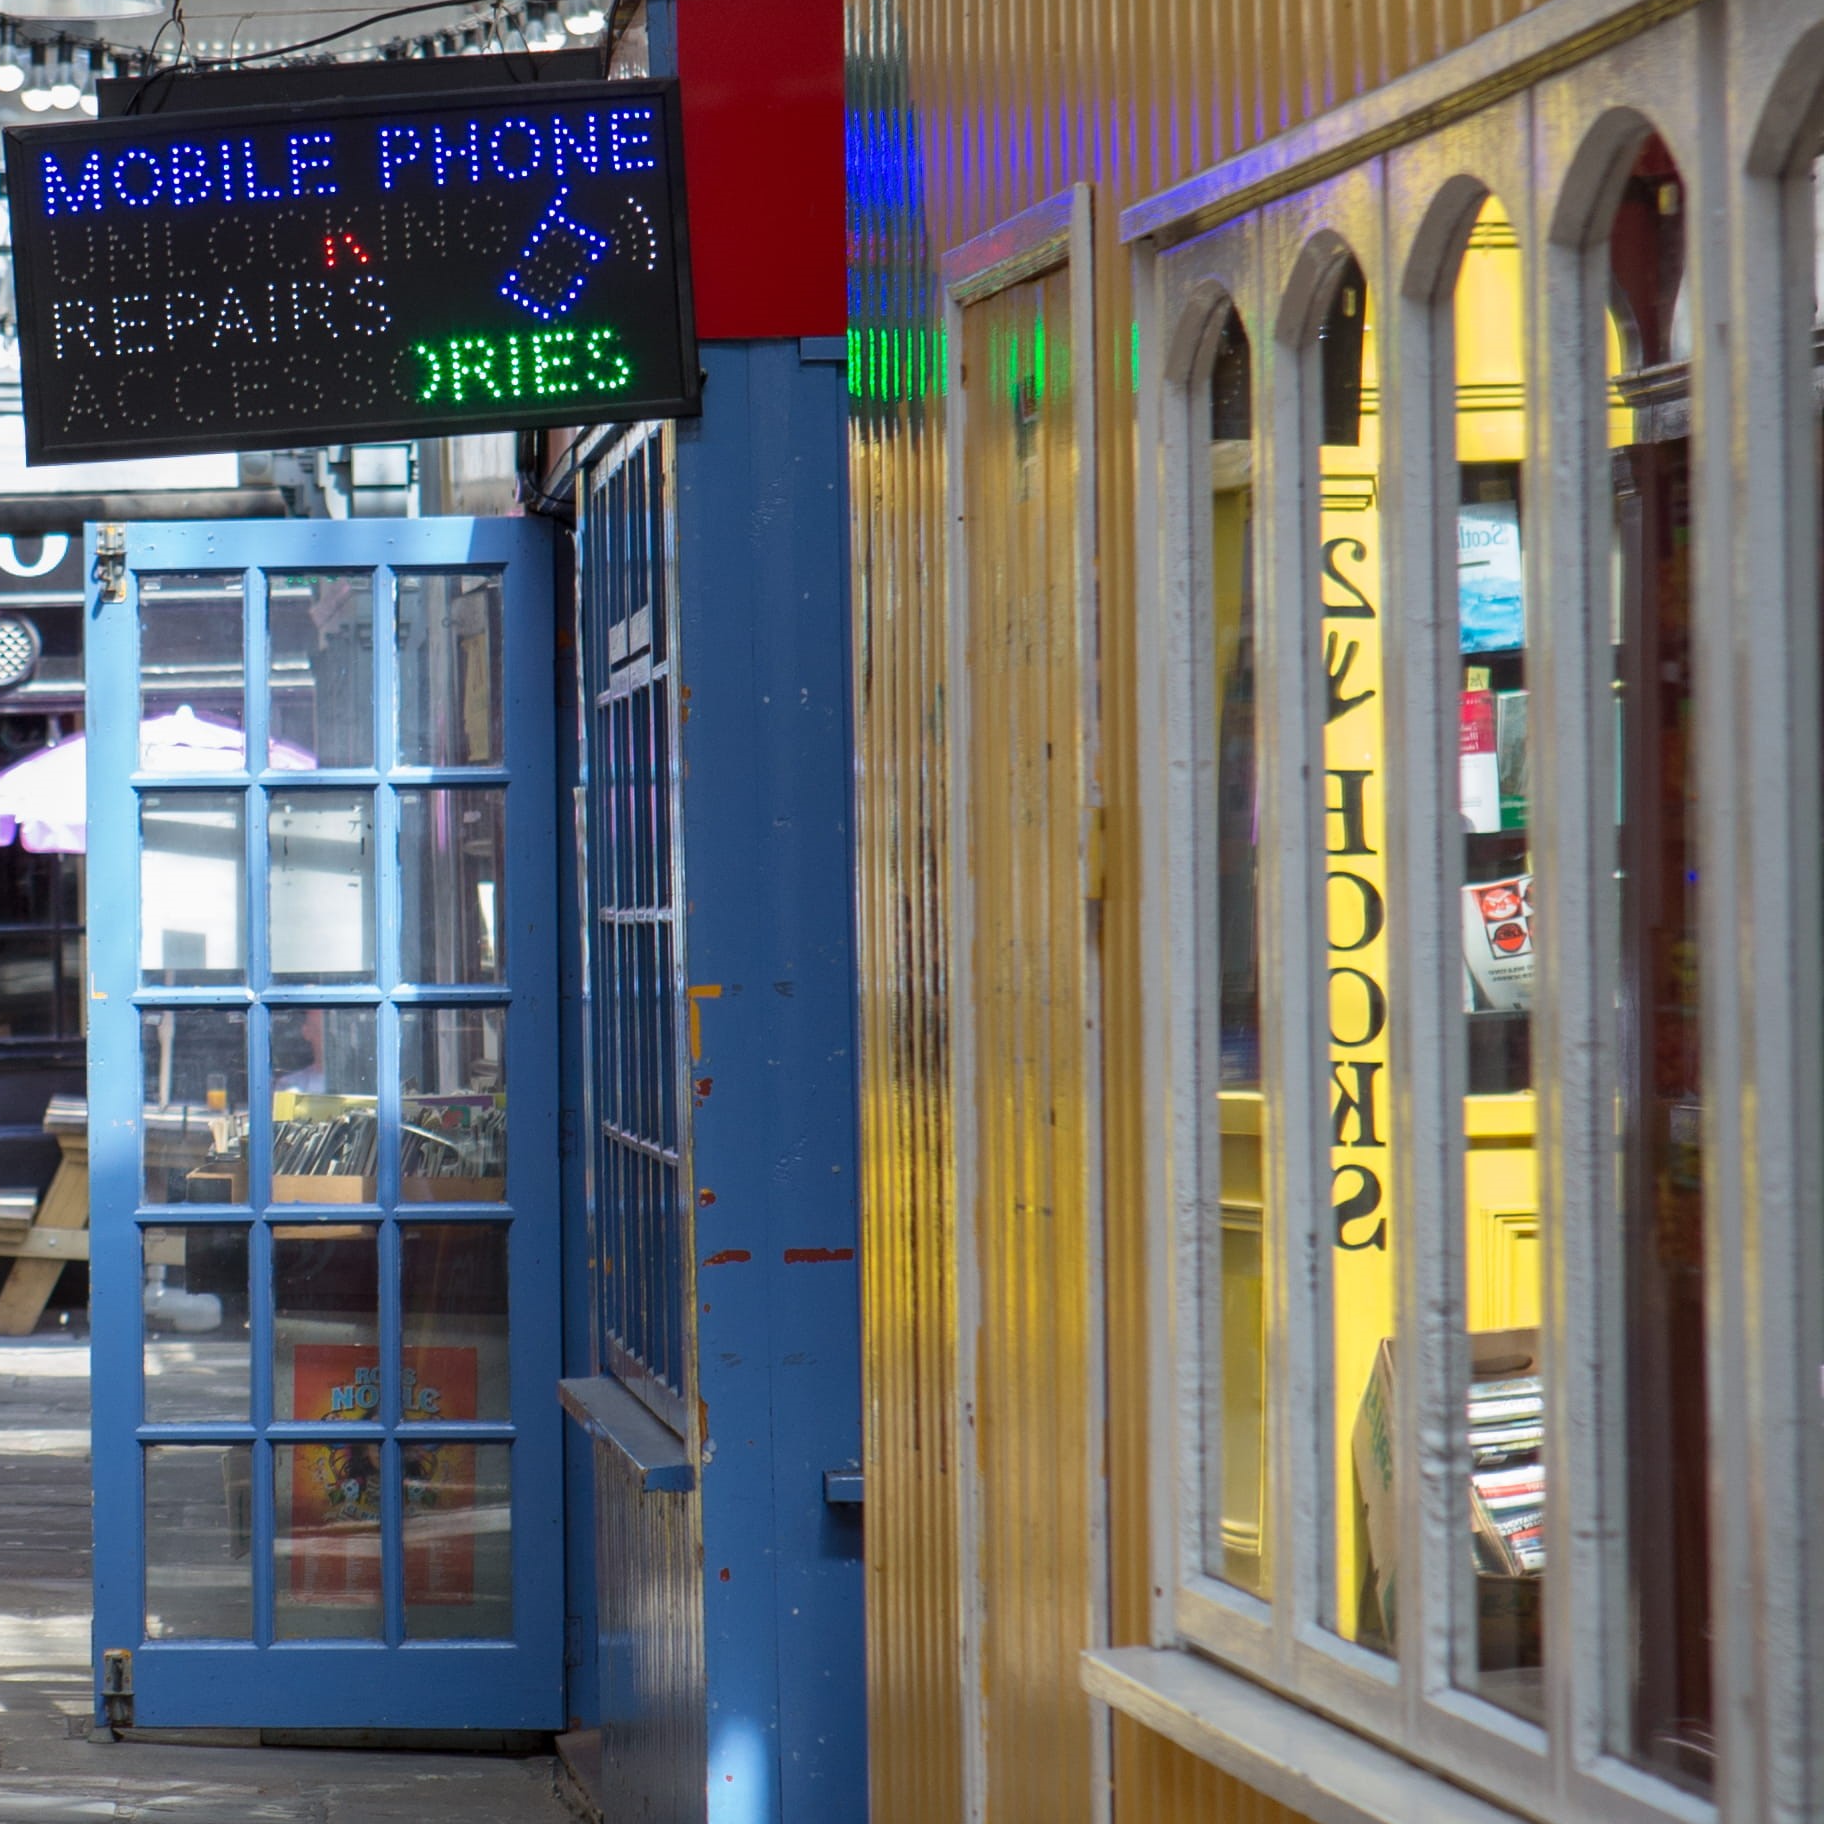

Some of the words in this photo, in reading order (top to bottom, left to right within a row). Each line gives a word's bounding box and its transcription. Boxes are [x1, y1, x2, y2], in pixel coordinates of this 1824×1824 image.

[44, 136, 337, 215] MOBILE
[382, 112, 655, 189] PHONE
[49, 194, 509, 285] UNLOCKING
[52, 276, 391, 359] REPAIRS
[63, 330, 631, 432] ACCESSORIES
[331, 1384, 442, 1414] NOLE
[355, 1366, 416, 1386] ROS
